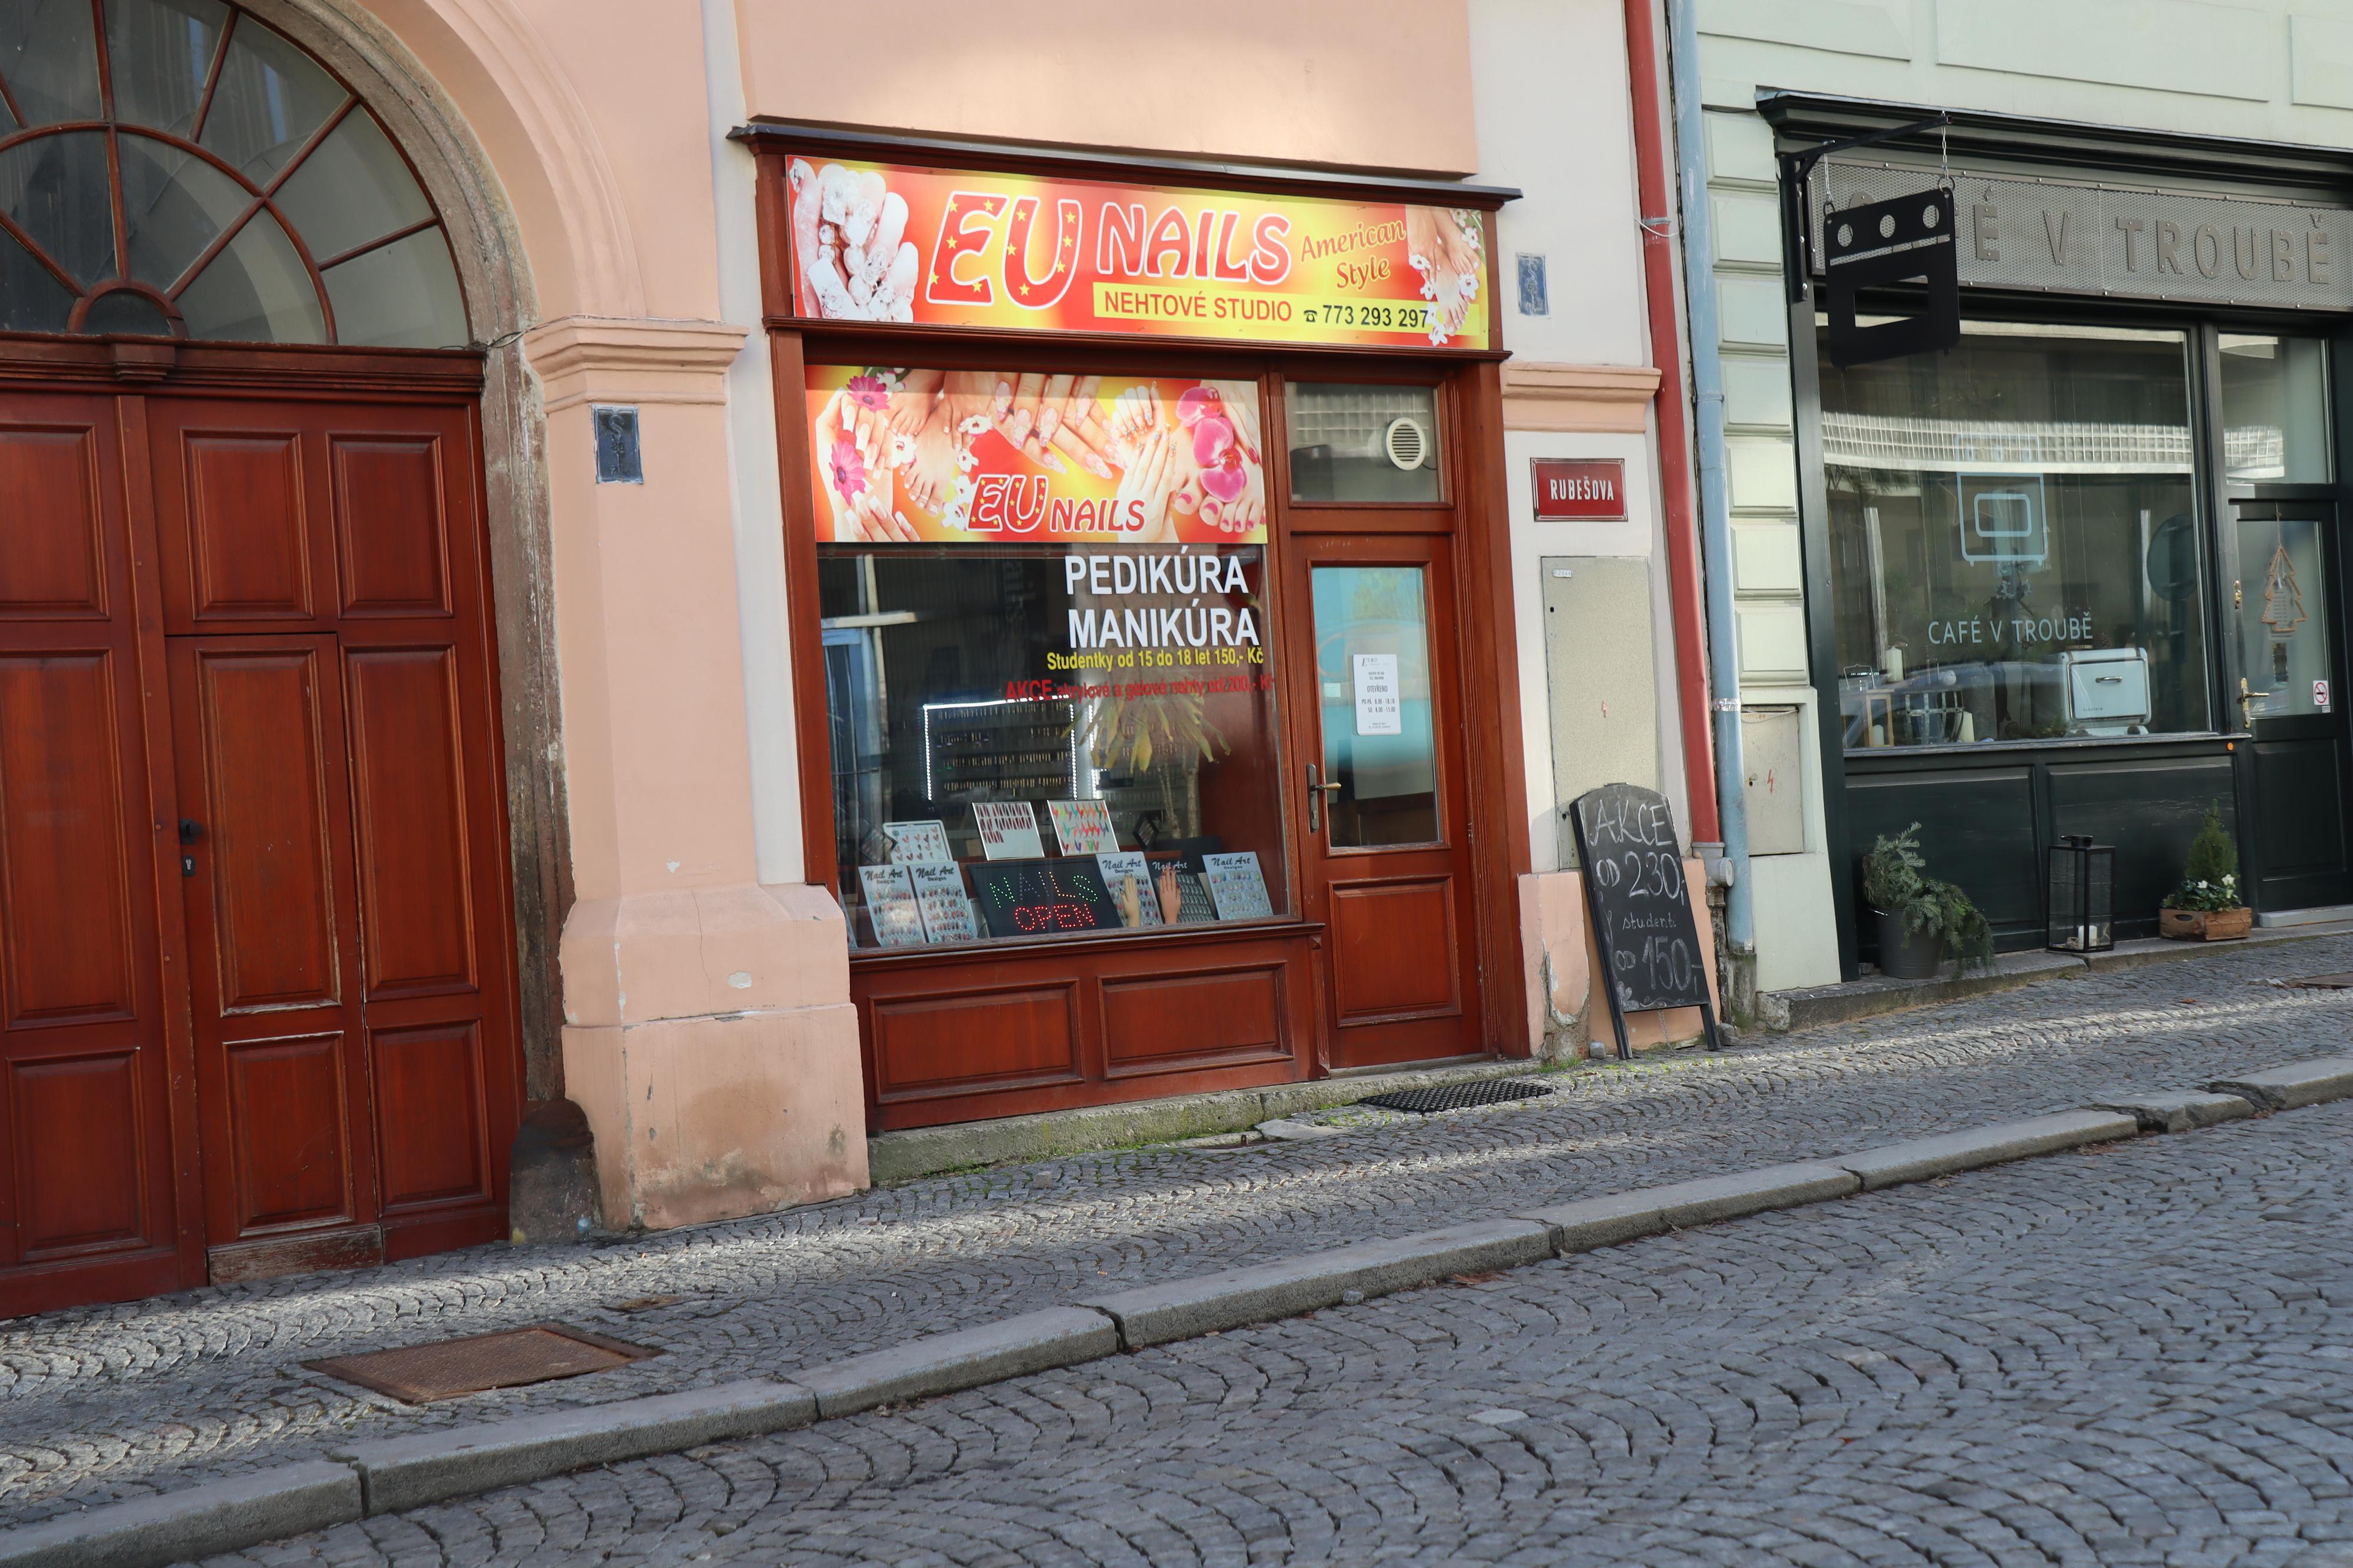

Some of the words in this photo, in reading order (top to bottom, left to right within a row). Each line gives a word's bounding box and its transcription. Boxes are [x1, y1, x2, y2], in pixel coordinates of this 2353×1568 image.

[926, 191, 1082, 311] EU
[1096, 202, 1292, 285] NAILS
[1301, 220, 1407, 263] American
[2043, 209, 2071, 265] V
[2117, 213, 2329, 283] TROUBĚ
[1337, 256, 1391, 291] Style
[1105, 291, 1207, 318] NEHTOVÉ
[1214, 297, 1292, 321] STUDIO
[1323, 305, 1354, 325] 773
[1361, 306, 1392, 326] 293
[1398, 309, 1429, 328] 297
[1550, 476, 1614, 501] RUBEŠOVA
[968, 474, 1049, 533] EU
[1049, 498, 1146, 533] NAILS
[1065, 545, 1249, 595] PEDIKÚRA
[1068, 598, 1260, 648] MANIKÚRA
[1928, 615, 1982, 644] CAFÉ
[1989, 620, 2002, 643] V
[2011, 612, 2093, 643] TROUBĚ
[1047, 651, 1113, 672] Studentky
[1118, 650, 1134, 668] od
[1138, 650, 1153, 666] 15
[1156, 649, 1173, 666] do
[1177, 649, 1192, 665] 18
[1195, 648, 1211, 665] let
[1215, 648, 1244, 668] 150,-
[1247, 646, 1264, 664] Kč
[1006, 679, 1052, 702] AKCE
[1114, 685, 1122, 697] a
[1126, 678, 1168, 701] gelové
[1171, 677, 1205, 698] nehty
[1209, 676, 1224, 693] od
[1228, 675, 1257, 695] 200,-
[1589, 799, 1673, 847] AKCE
[865, 869, 885, 881] Nail
[888, 868, 904, 878] Art
[915, 866, 936, 878] Nail
[939, 865, 955, 876] Art
[1102, 859, 1124, 870] Nail
[1125, 858, 1142, 868] Art
[1211, 857, 1232, 866] Nail
[1235, 856, 1251, 865] Art
[1596, 858, 1621, 887] OD
[989, 871, 1099, 908] NAILS
[1015, 903, 1095, 930] OPEN
[1622, 912, 1677, 930] studenti
[1615, 950, 1635, 970] OD
